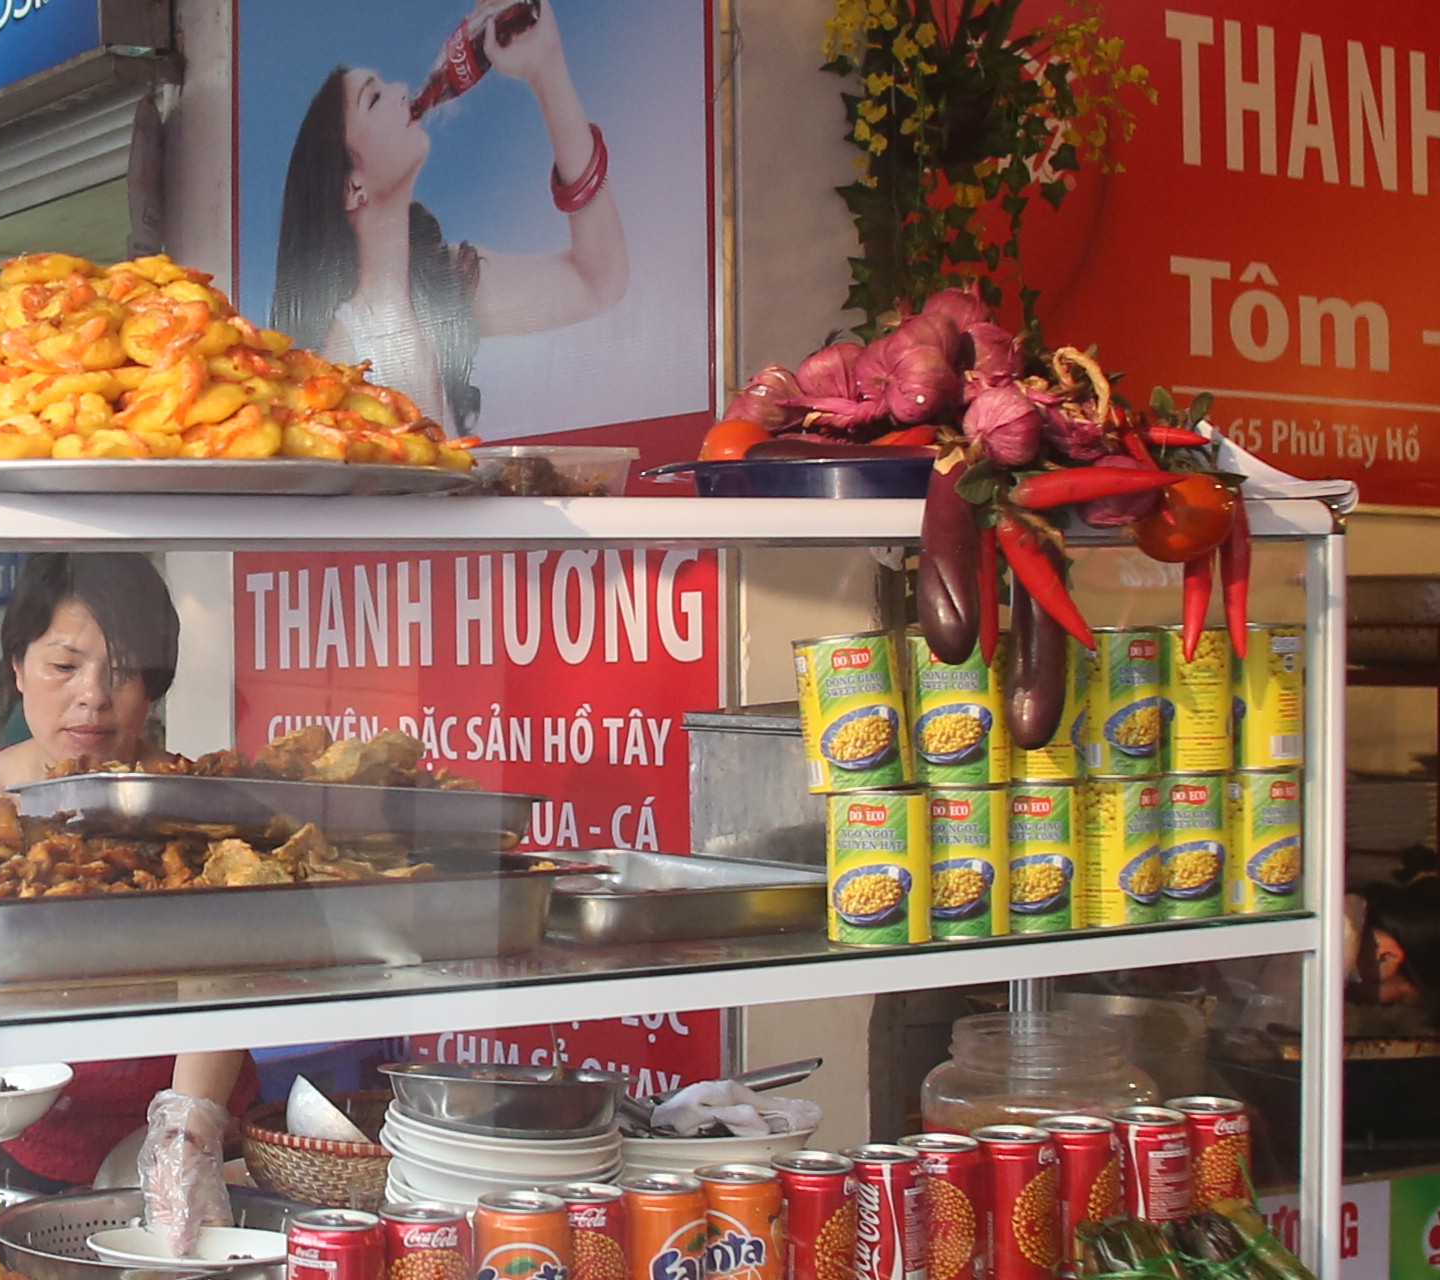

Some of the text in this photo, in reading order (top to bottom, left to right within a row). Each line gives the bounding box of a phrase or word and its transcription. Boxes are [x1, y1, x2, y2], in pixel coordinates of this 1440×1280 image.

[1169, 254, 1391, 373] Tôm
[1227, 419, 1264, 453] 65
[1270, 420, 1326, 458] Phủ
[1331, 424, 1380, 470] Tây
[1386, 422, 1420, 463] Hồ
[247, 549, 705, 670] THANH HƯƠNG
[465, 703, 532, 762] SẢN
[543, 703, 594, 765] HỒ
[603, 707, 673, 767] TÂY
[520, 797, 660, 852] UA CÁ
[403, 1226, 459, 1249] Coca-Cola
